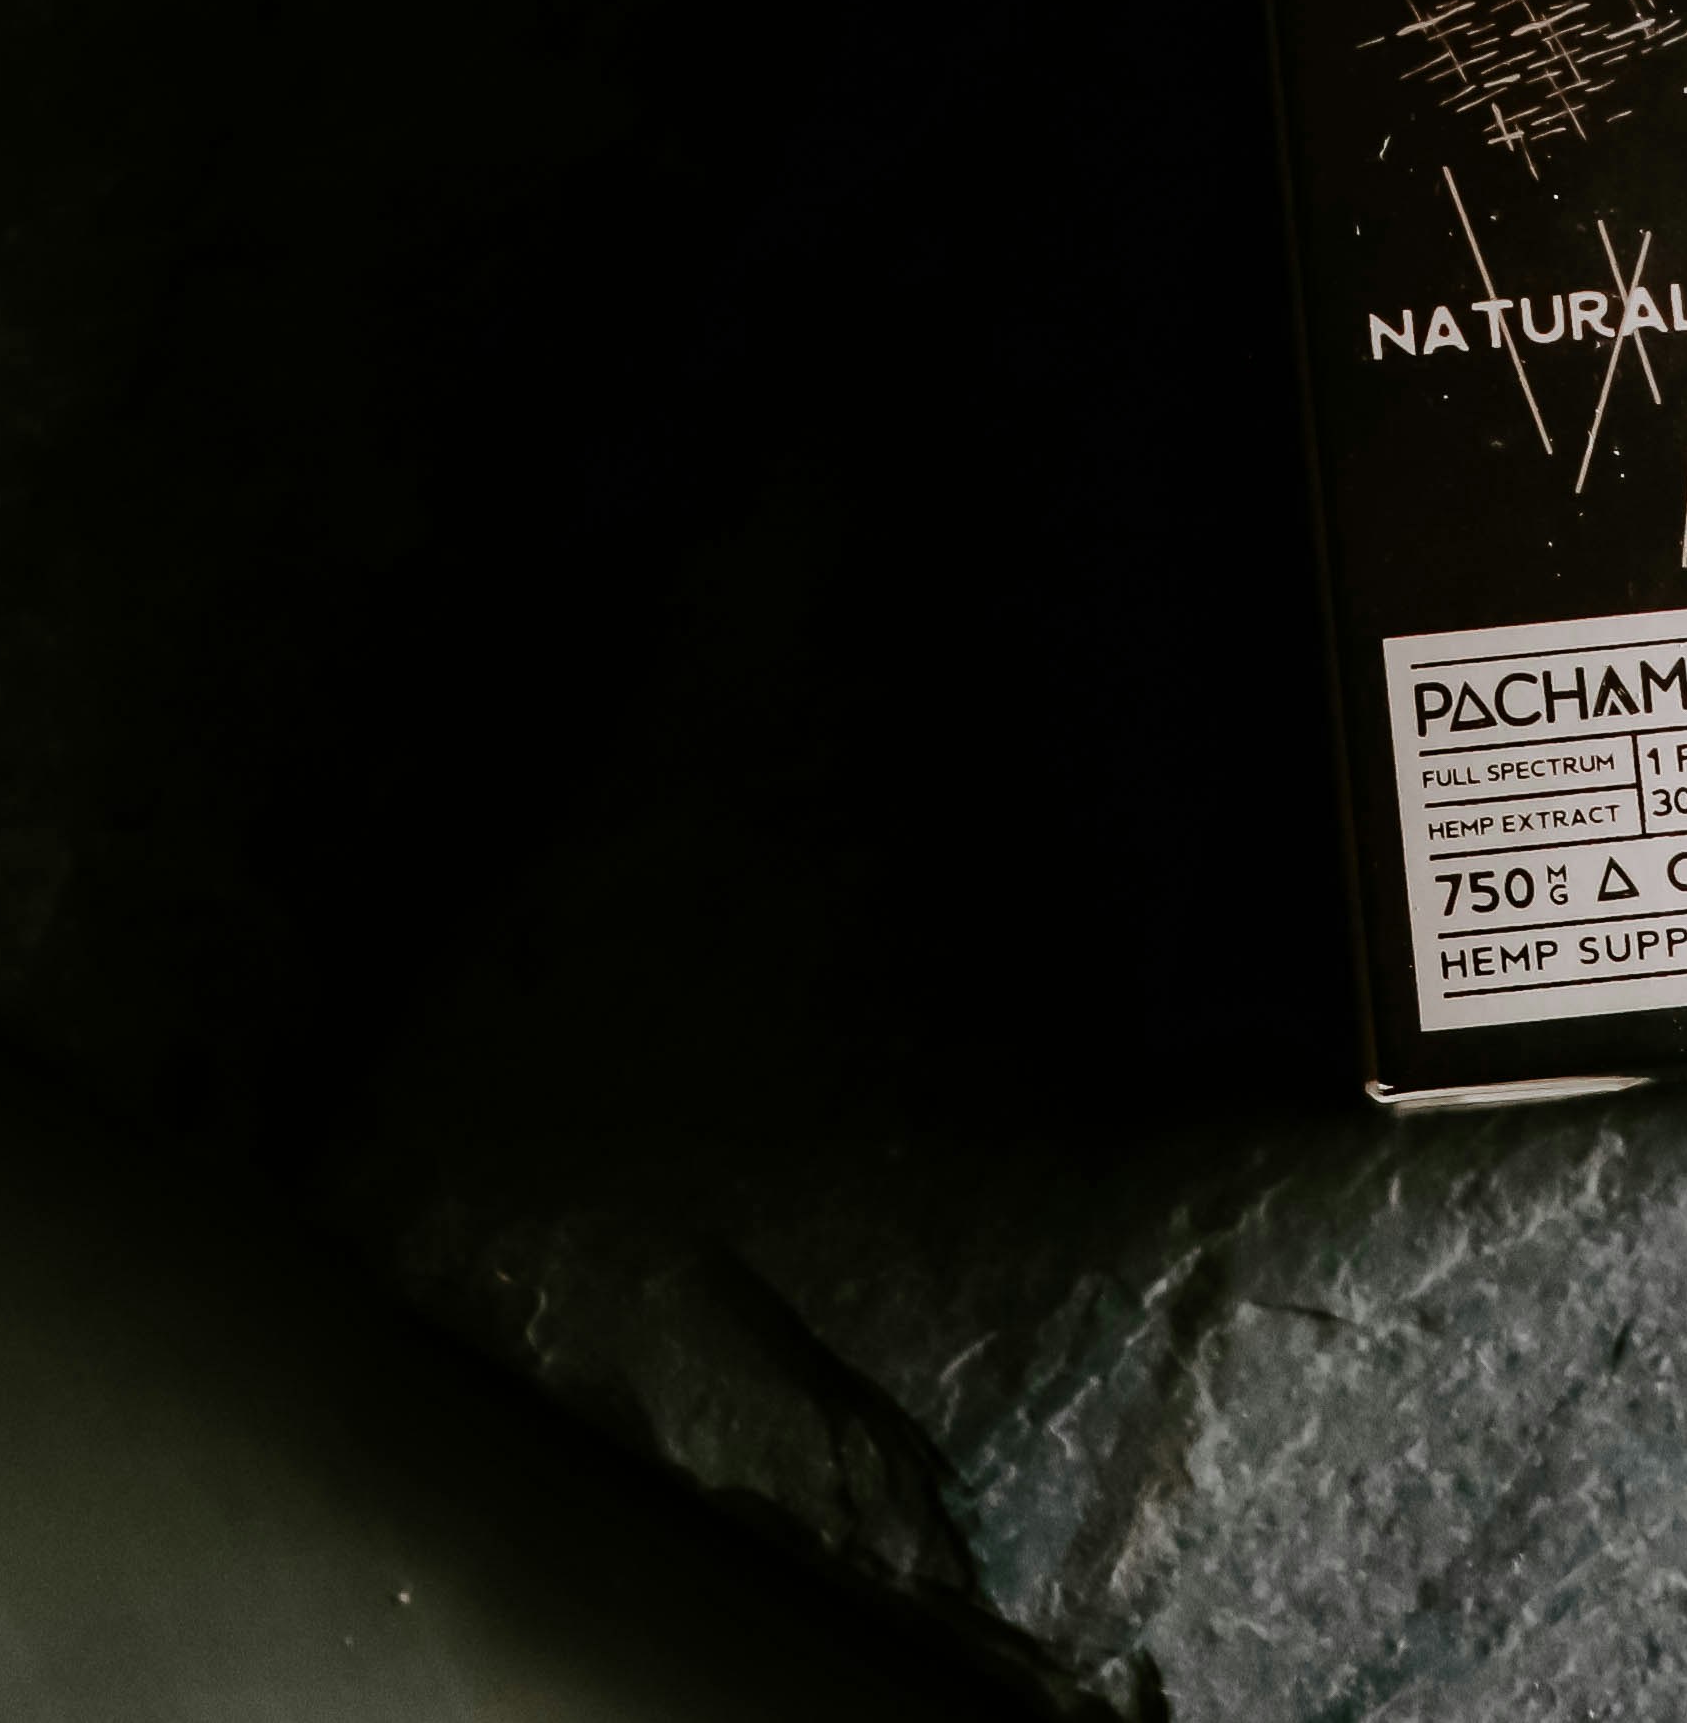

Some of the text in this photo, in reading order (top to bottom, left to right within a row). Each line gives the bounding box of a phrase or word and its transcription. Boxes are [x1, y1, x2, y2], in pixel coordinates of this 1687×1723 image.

[1421, 753, 1615, 789] FULL SPECTRUM
[1646, 748, 1661, 776] 1
[1427, 805, 1620, 841] HEMP EXTRACT
[1434, 867, 1535, 917] 750
[1440, 940, 1559, 980] HEMP
